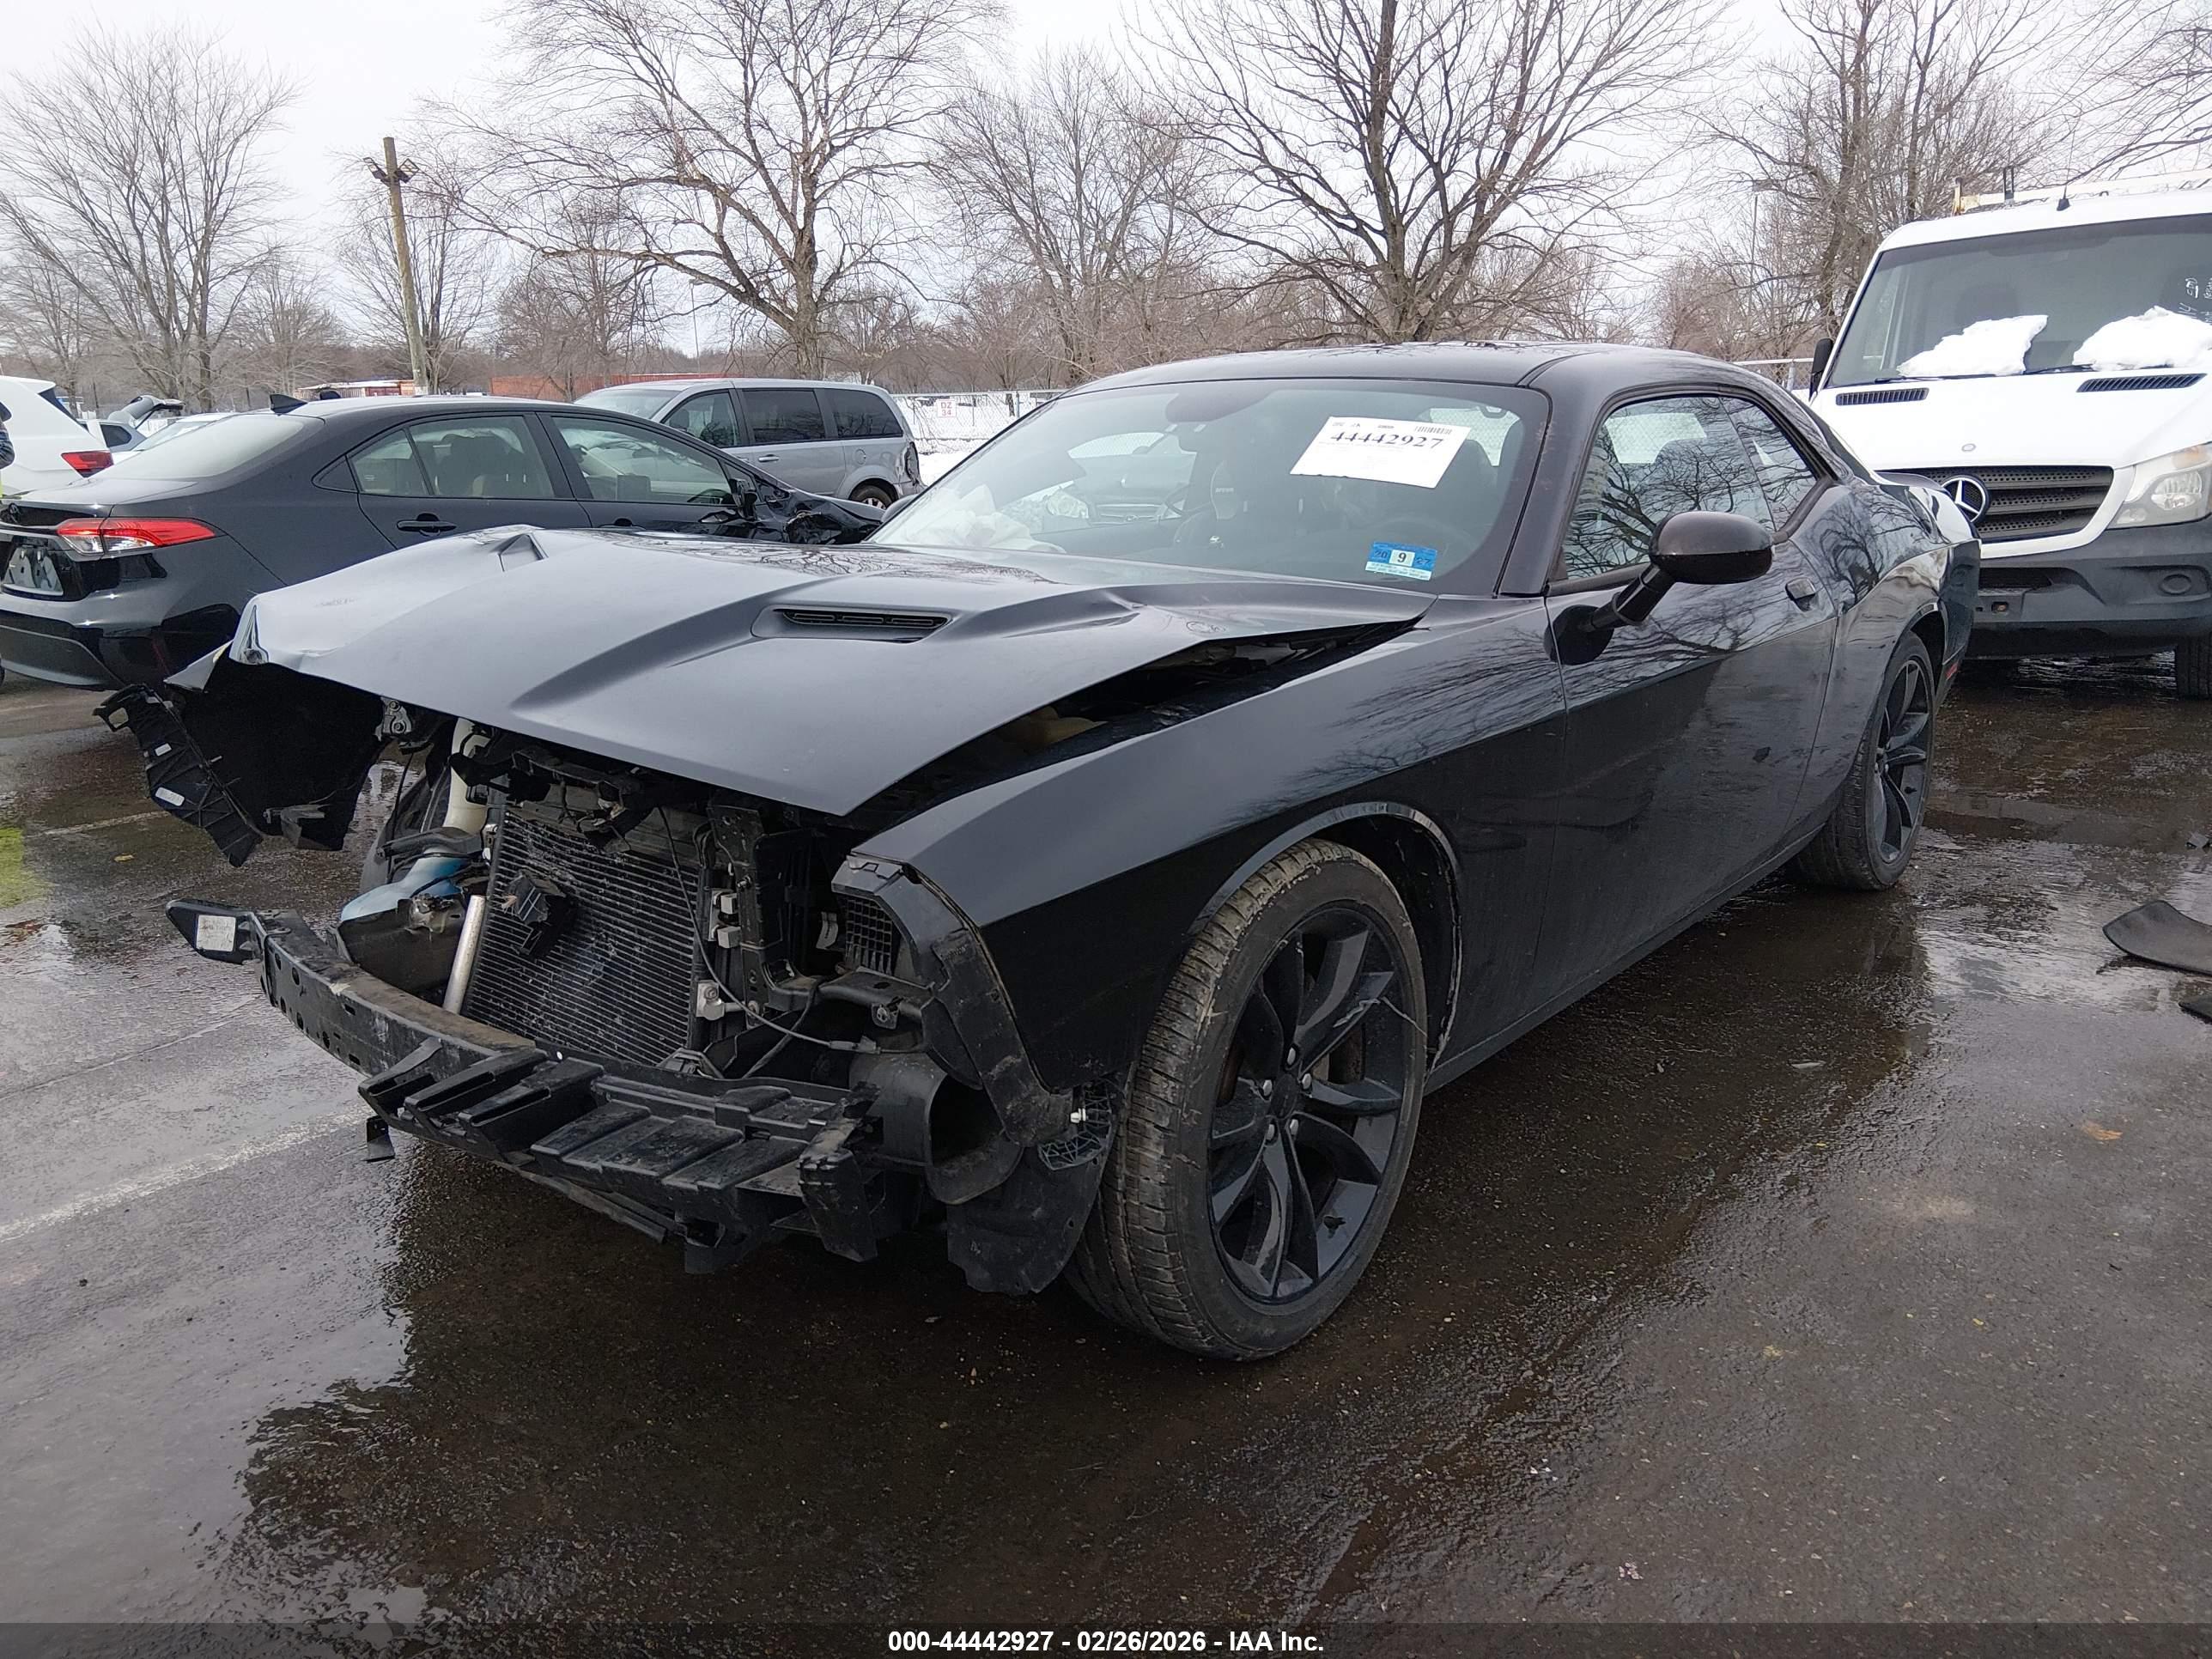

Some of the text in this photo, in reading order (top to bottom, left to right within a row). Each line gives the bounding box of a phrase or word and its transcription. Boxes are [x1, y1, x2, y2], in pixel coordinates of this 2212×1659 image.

[1331, 431, 1444, 449] 44442927
[1374, 550, 1388, 559] 20
[1397, 552, 1407, 563] 9
